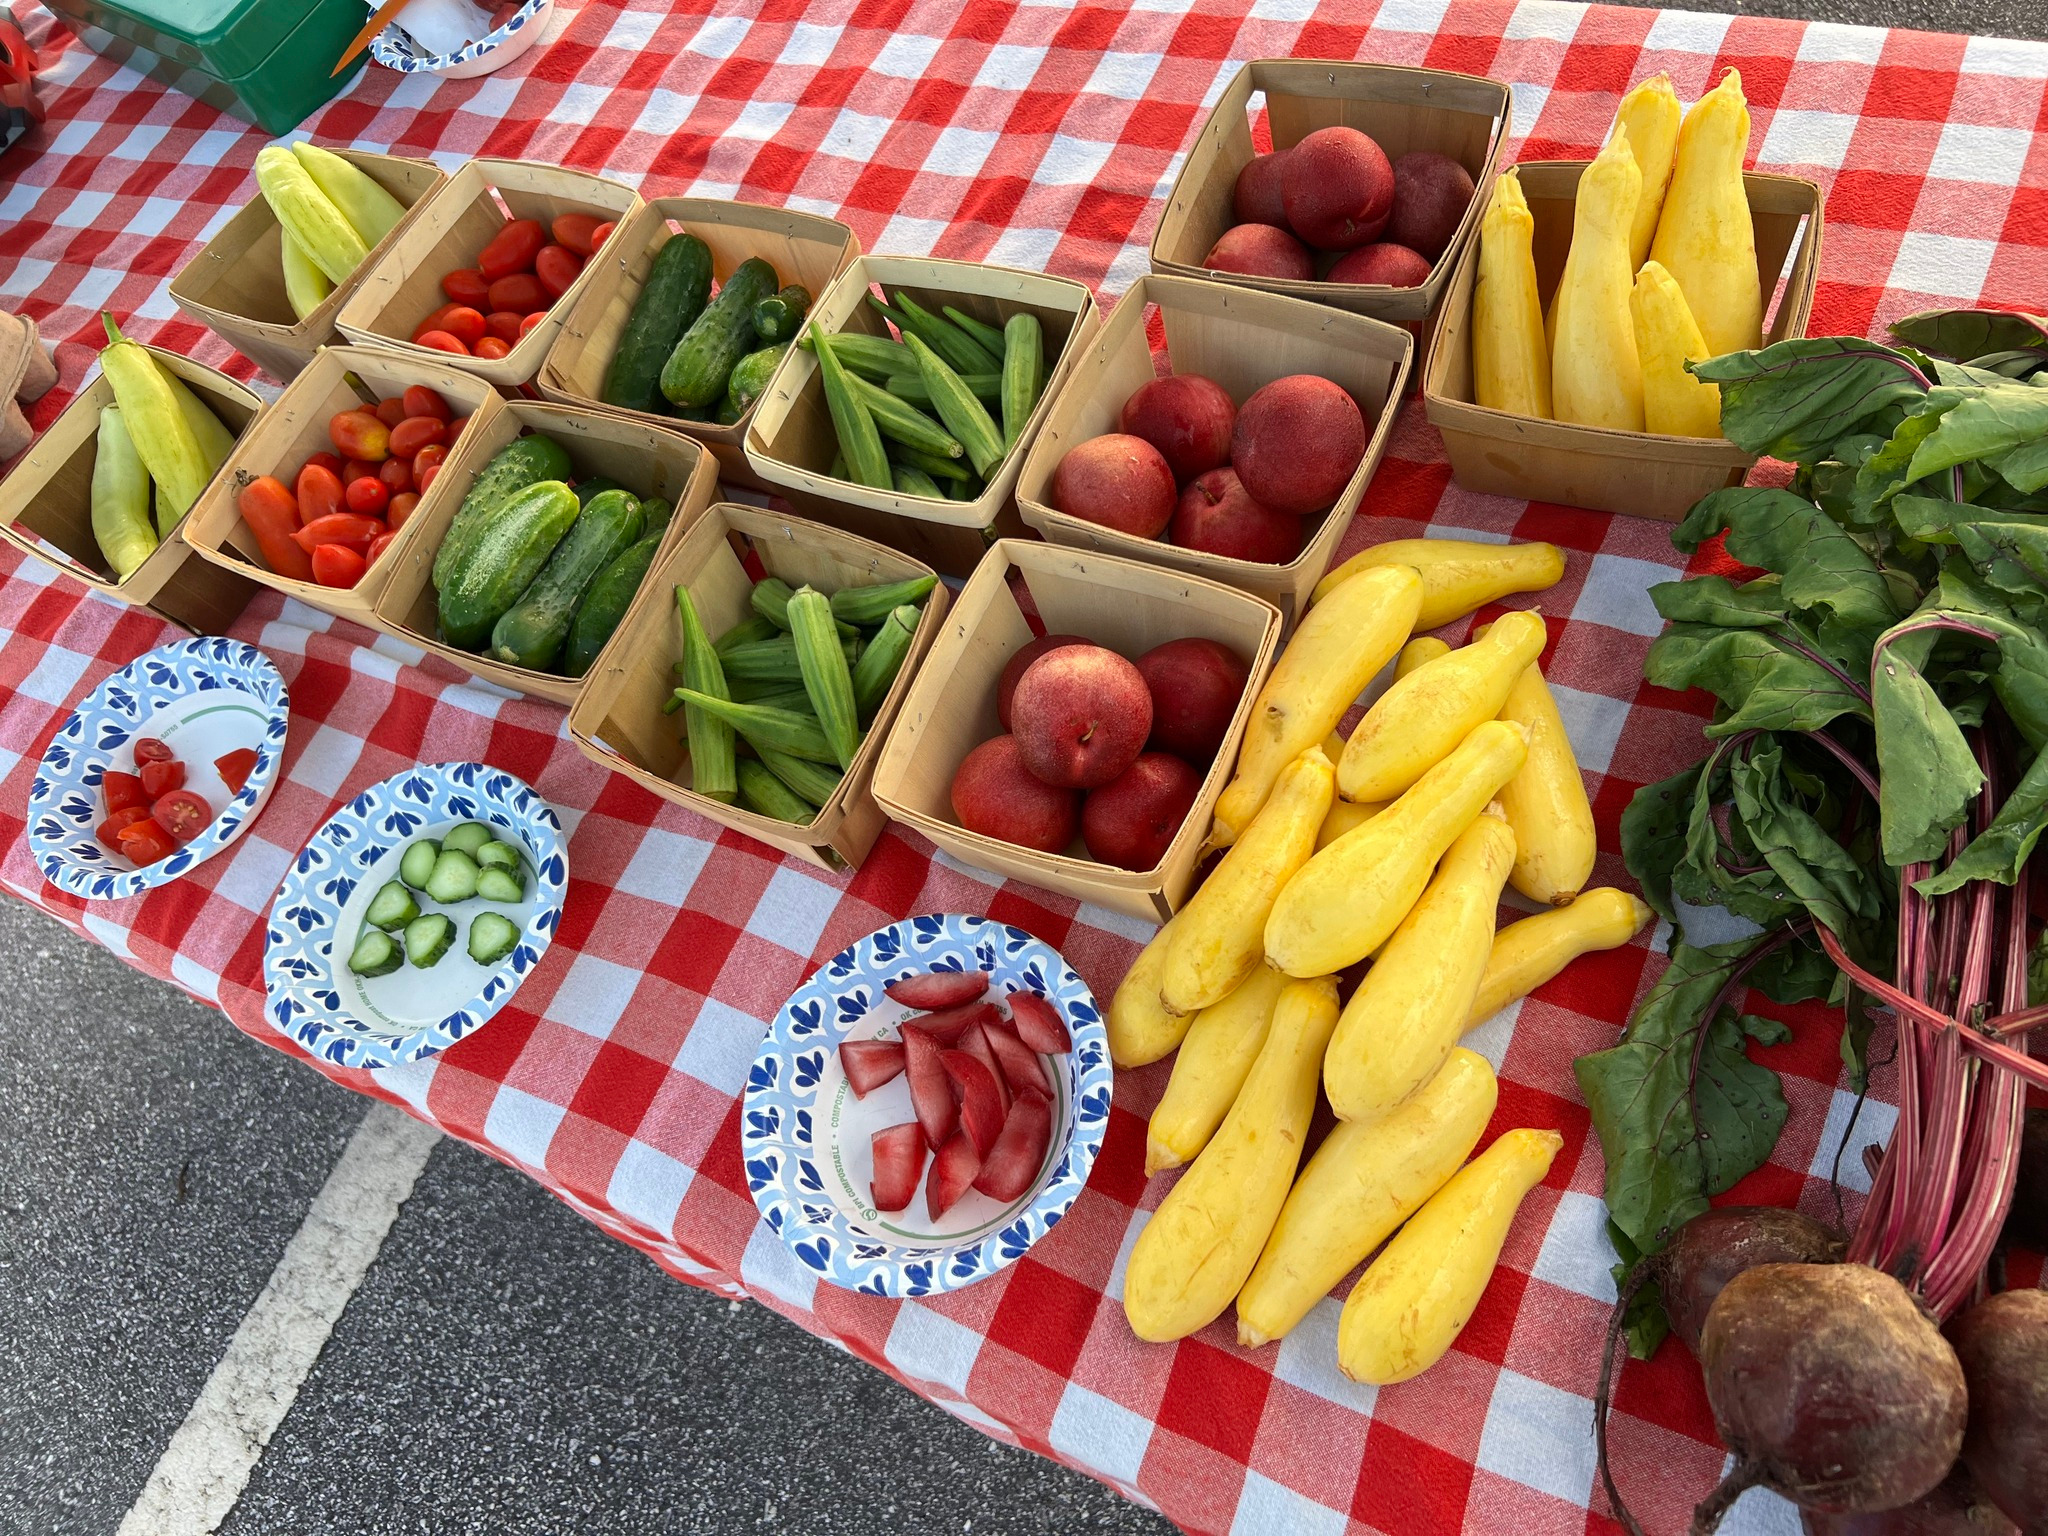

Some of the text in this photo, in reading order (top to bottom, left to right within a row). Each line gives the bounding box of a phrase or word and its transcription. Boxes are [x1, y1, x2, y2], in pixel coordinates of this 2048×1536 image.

[358, 991, 372, 1007] HOME
[368, 1005, 390, 1022] compost
[900, 1010, 913, 1022] OK
[878, 1026, 889, 1038] CA
[831, 1076, 849, 1128] COMPOSTAB
[831, 1144, 865, 1210] BPI COMPOSTABLE
